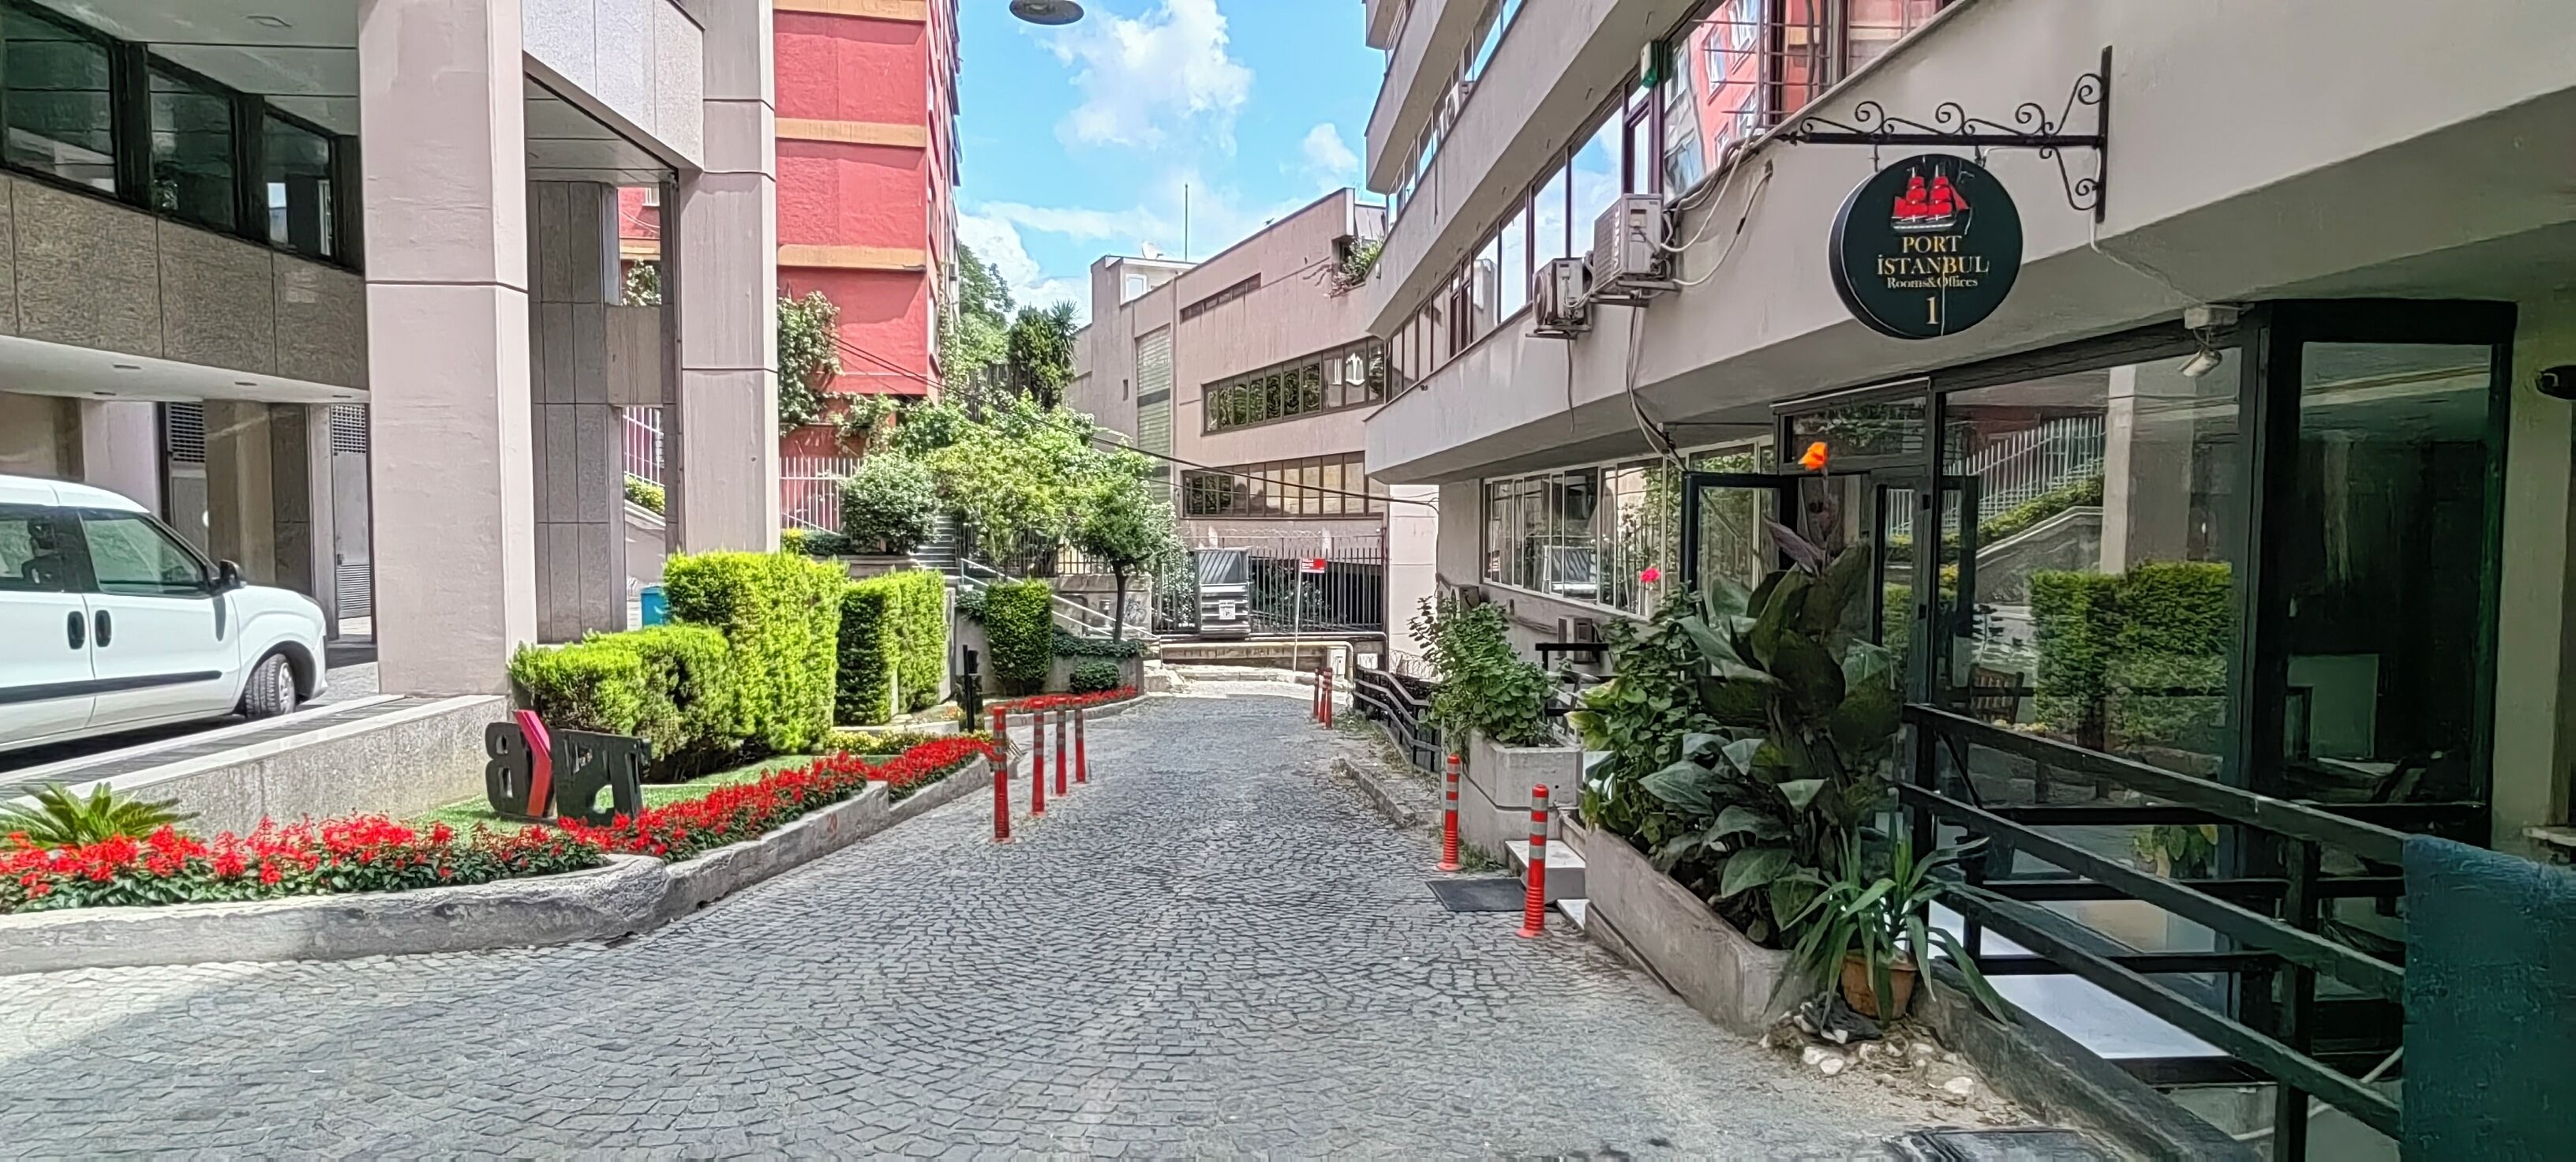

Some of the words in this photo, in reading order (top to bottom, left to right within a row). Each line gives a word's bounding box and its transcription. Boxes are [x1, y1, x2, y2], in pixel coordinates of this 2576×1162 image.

[1903, 236, 1962, 253] PORT
[1878, 254, 1989, 275] İSTANBUL
[1887, 276, 1978, 289] Rooms&Offices
[1926, 296, 1940, 324] 1
